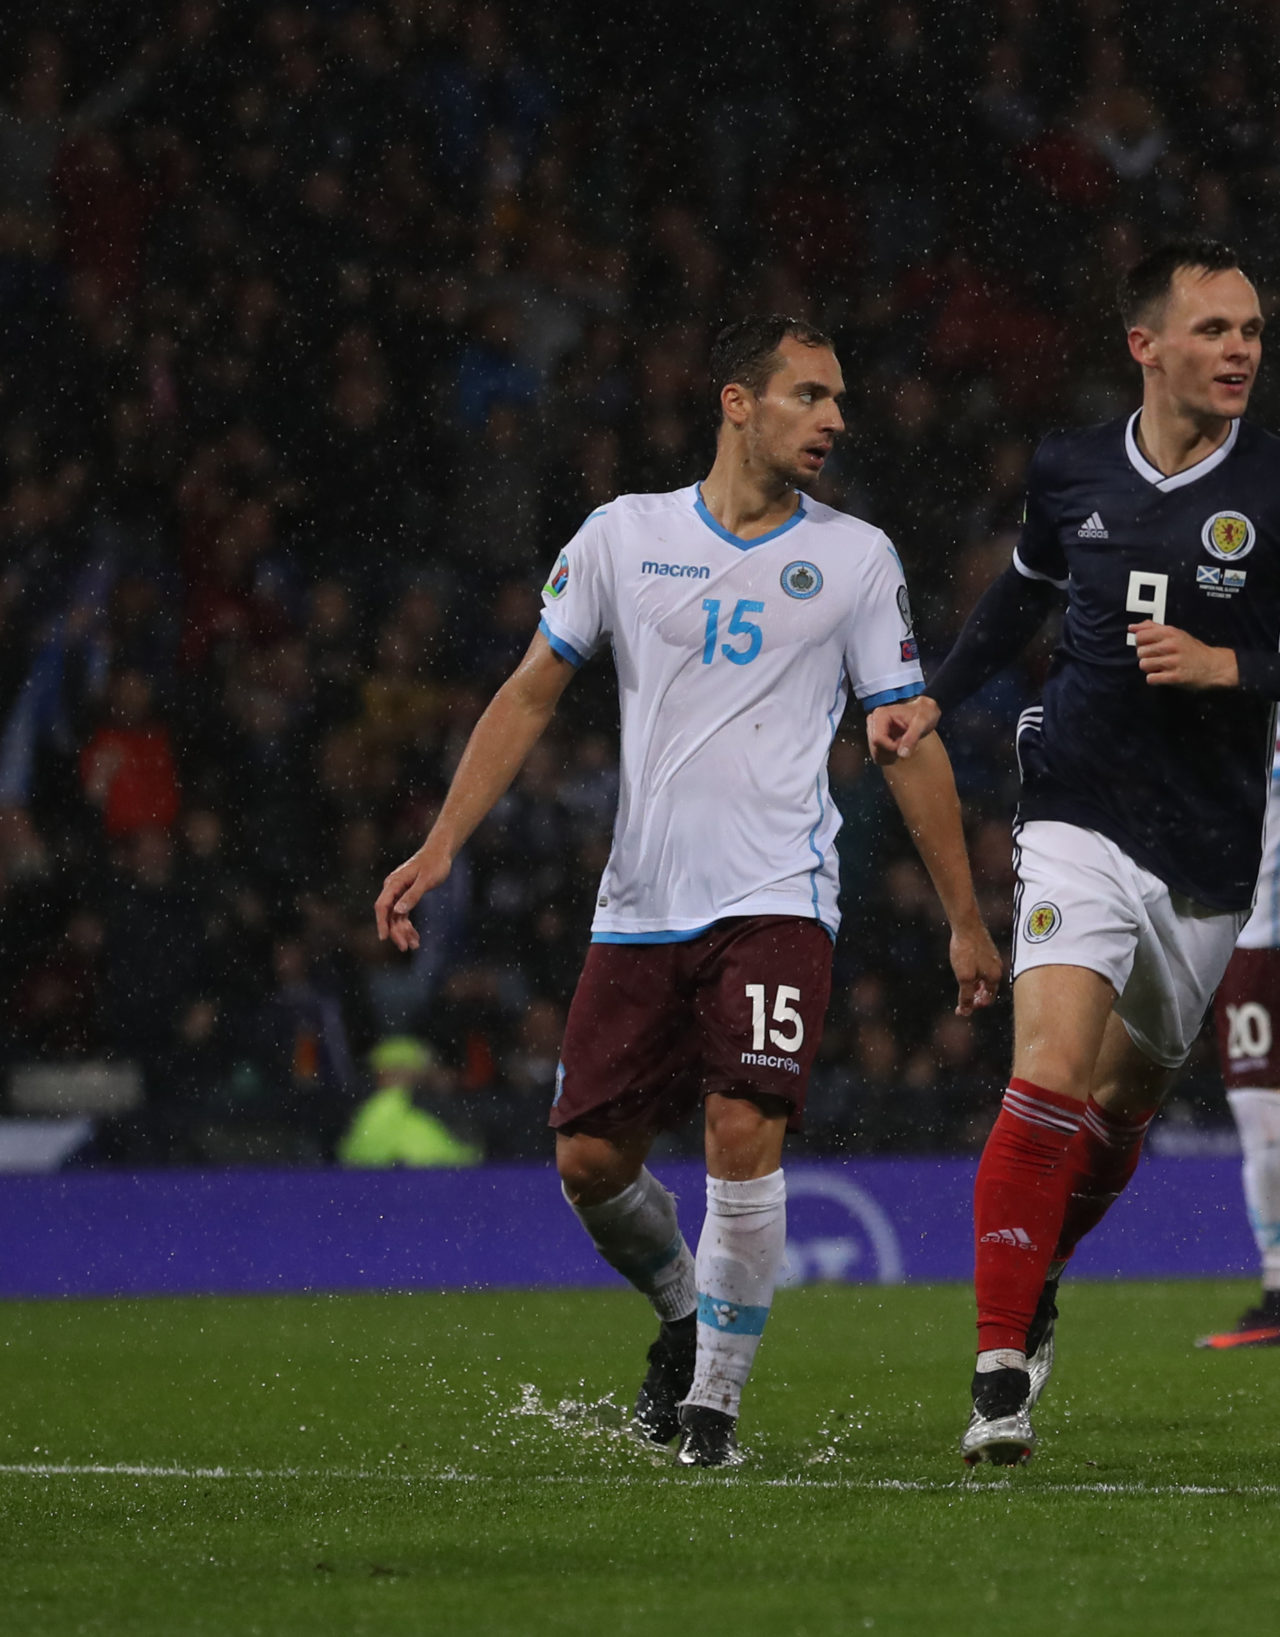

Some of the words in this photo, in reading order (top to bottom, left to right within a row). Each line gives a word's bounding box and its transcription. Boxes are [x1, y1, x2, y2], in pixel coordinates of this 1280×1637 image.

[641, 560, 711, 579] macron
[702, 598, 766, 666] 15
[1126, 570, 1169, 647] 9
[745, 983, 804, 1053] 15
[741, 1052, 800, 1075] macron
